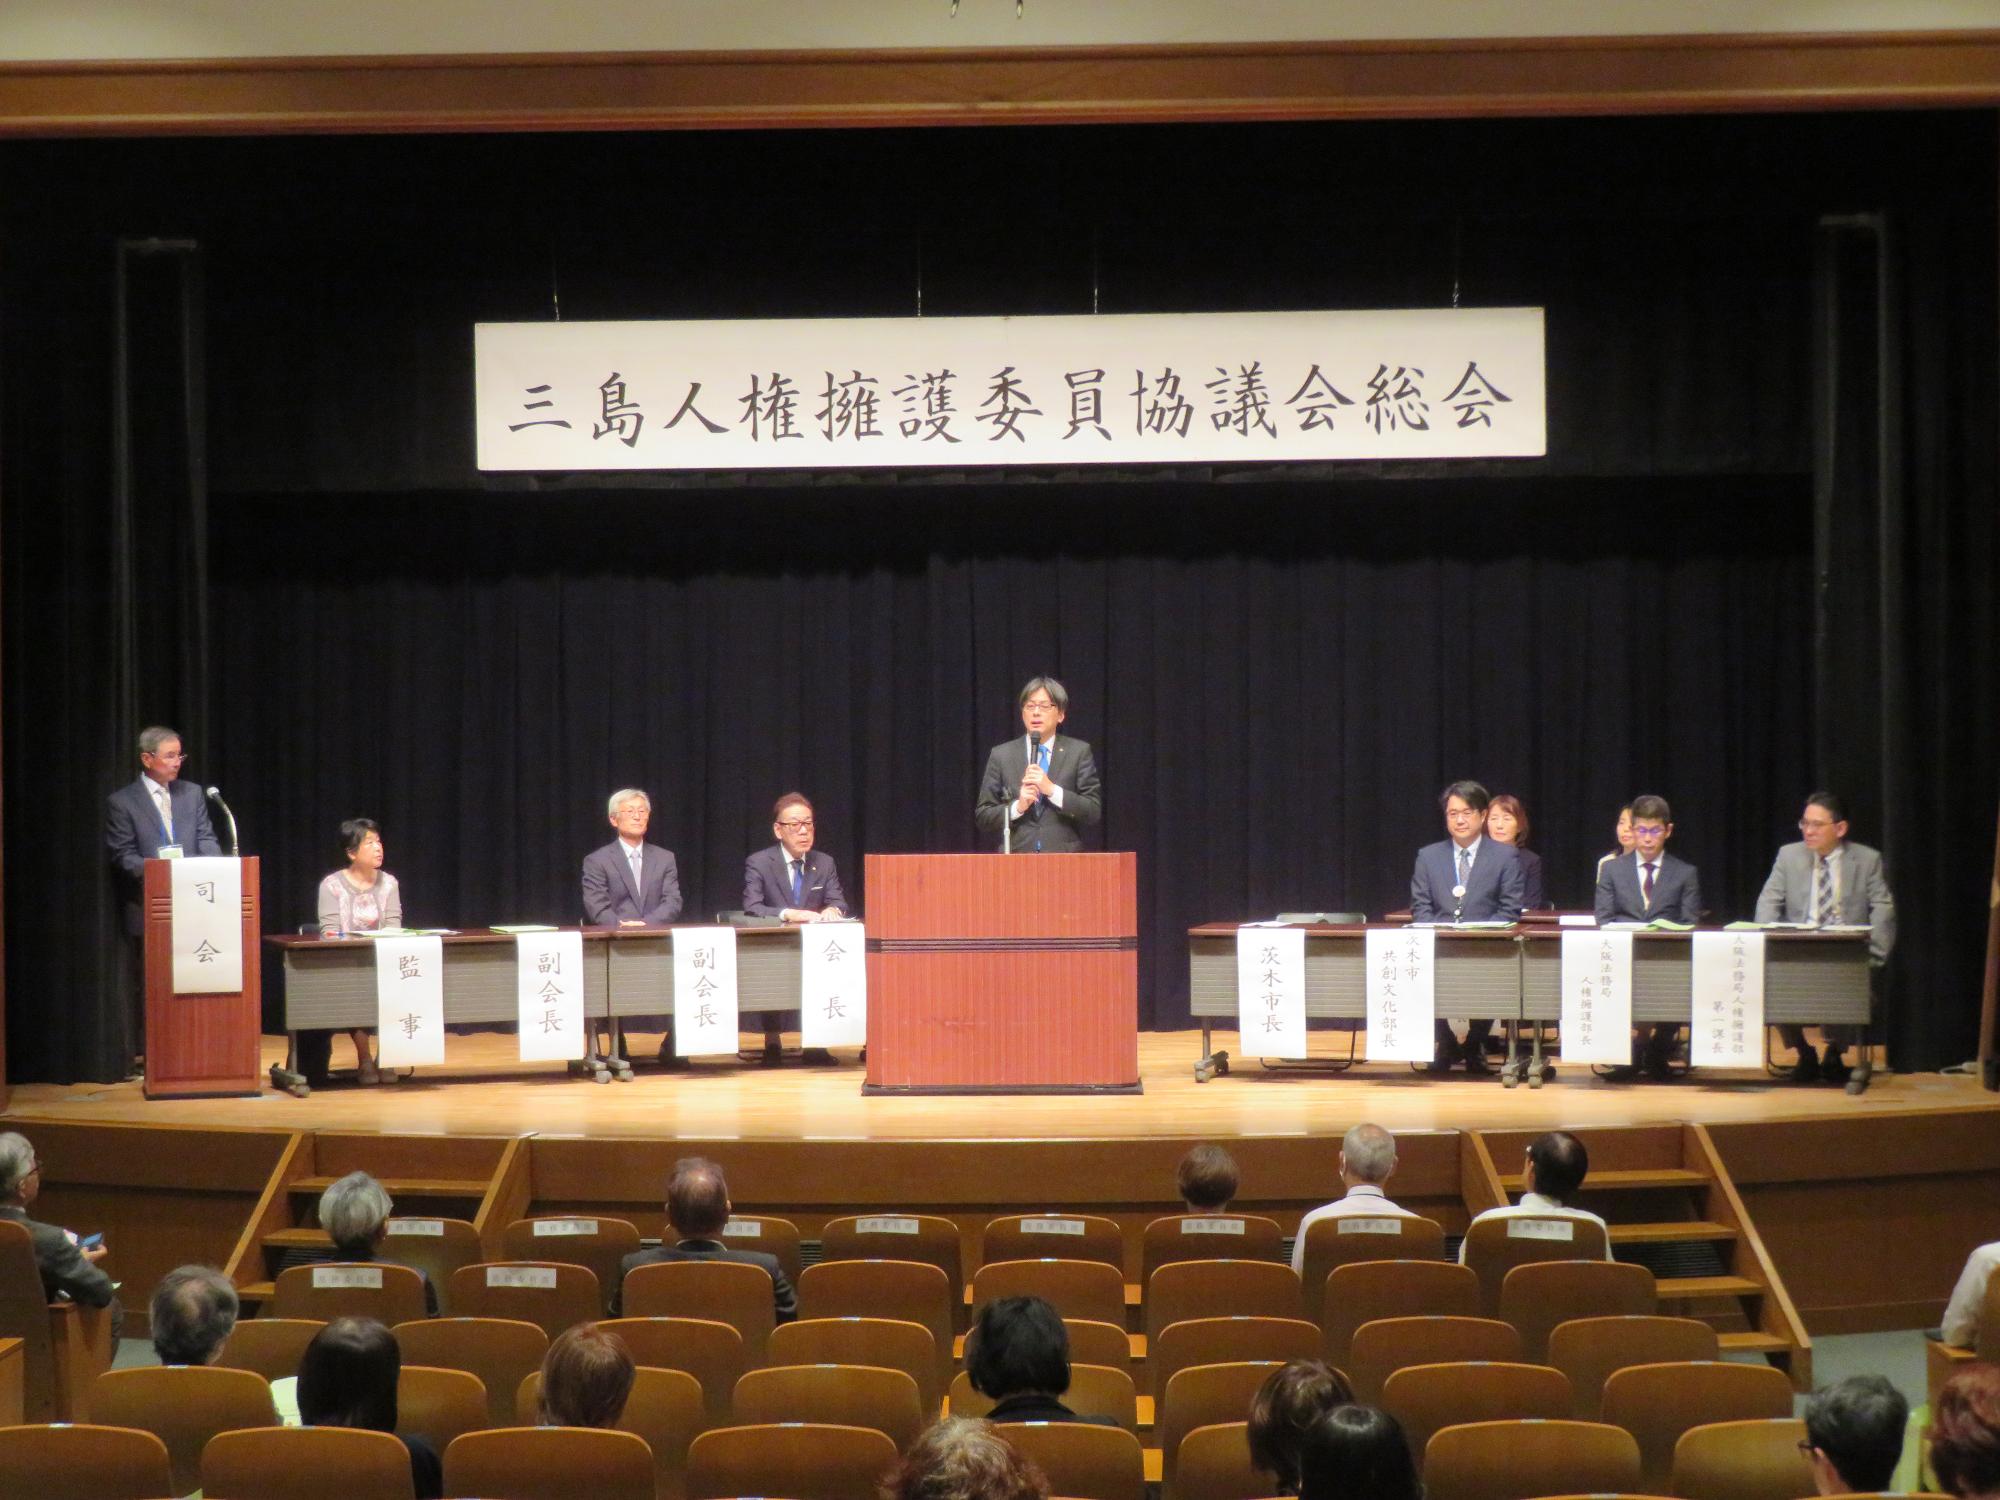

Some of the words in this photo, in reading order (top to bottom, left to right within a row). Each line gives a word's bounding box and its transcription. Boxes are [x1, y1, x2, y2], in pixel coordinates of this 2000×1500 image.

[508, 360, 1513, 447] 三島人権擁護委員協議会総会
[193, 881, 222, 963] 司会
[398, 955, 423, 1040] 監事
[537, 952, 565, 1034] 副会長
[692, 947, 719, 1028] 副会長
[822, 939, 848, 1020] 会長
[1260, 946, 1283, 1033] 茨木市長
[1381, 949, 1398, 1048] 共創文化部長
[1600, 938, 1614, 999] 大阪法務局
[1580, 976, 1594, 1047] 人権擁護部長
[1711, 1000, 1727, 1054] 第一課長
